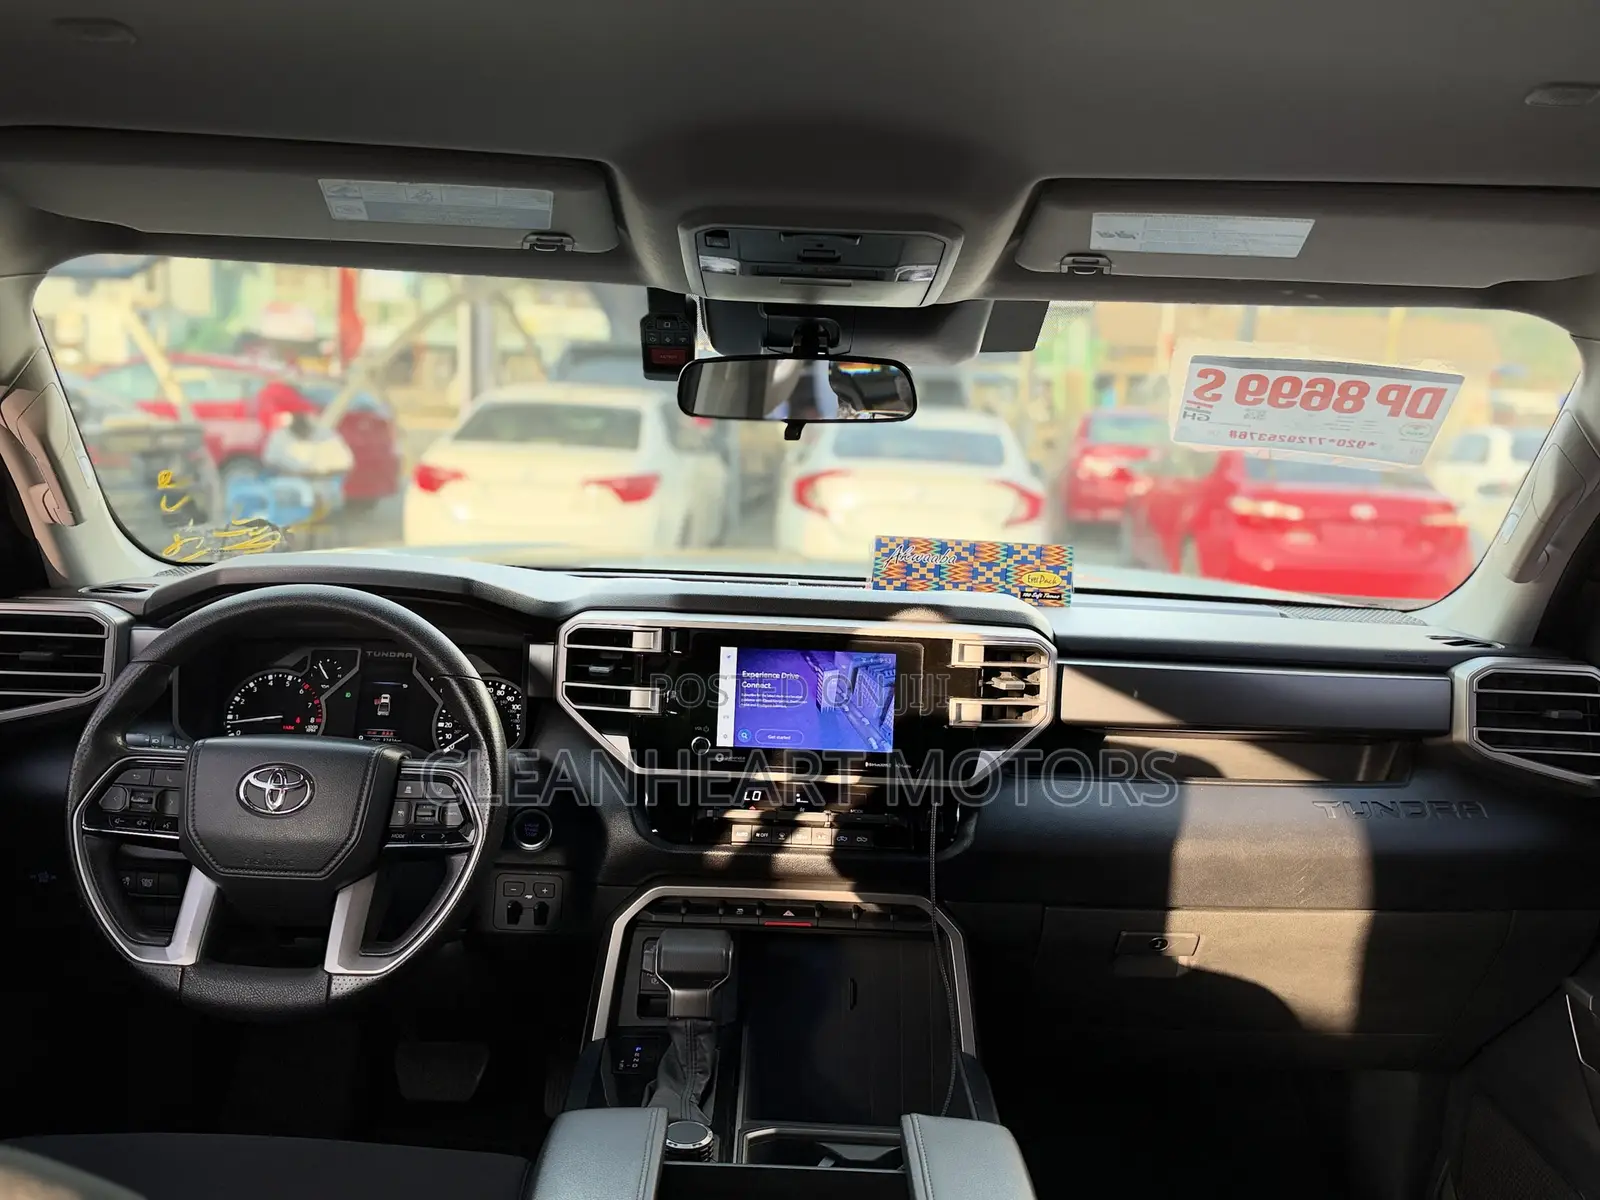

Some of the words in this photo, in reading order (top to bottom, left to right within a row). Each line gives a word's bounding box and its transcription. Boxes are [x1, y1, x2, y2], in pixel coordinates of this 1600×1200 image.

[741, 670, 780, 680] Experience
[781, 672, 800, 680] Drive
[1312, 800, 1489, 820] TUNDRA
